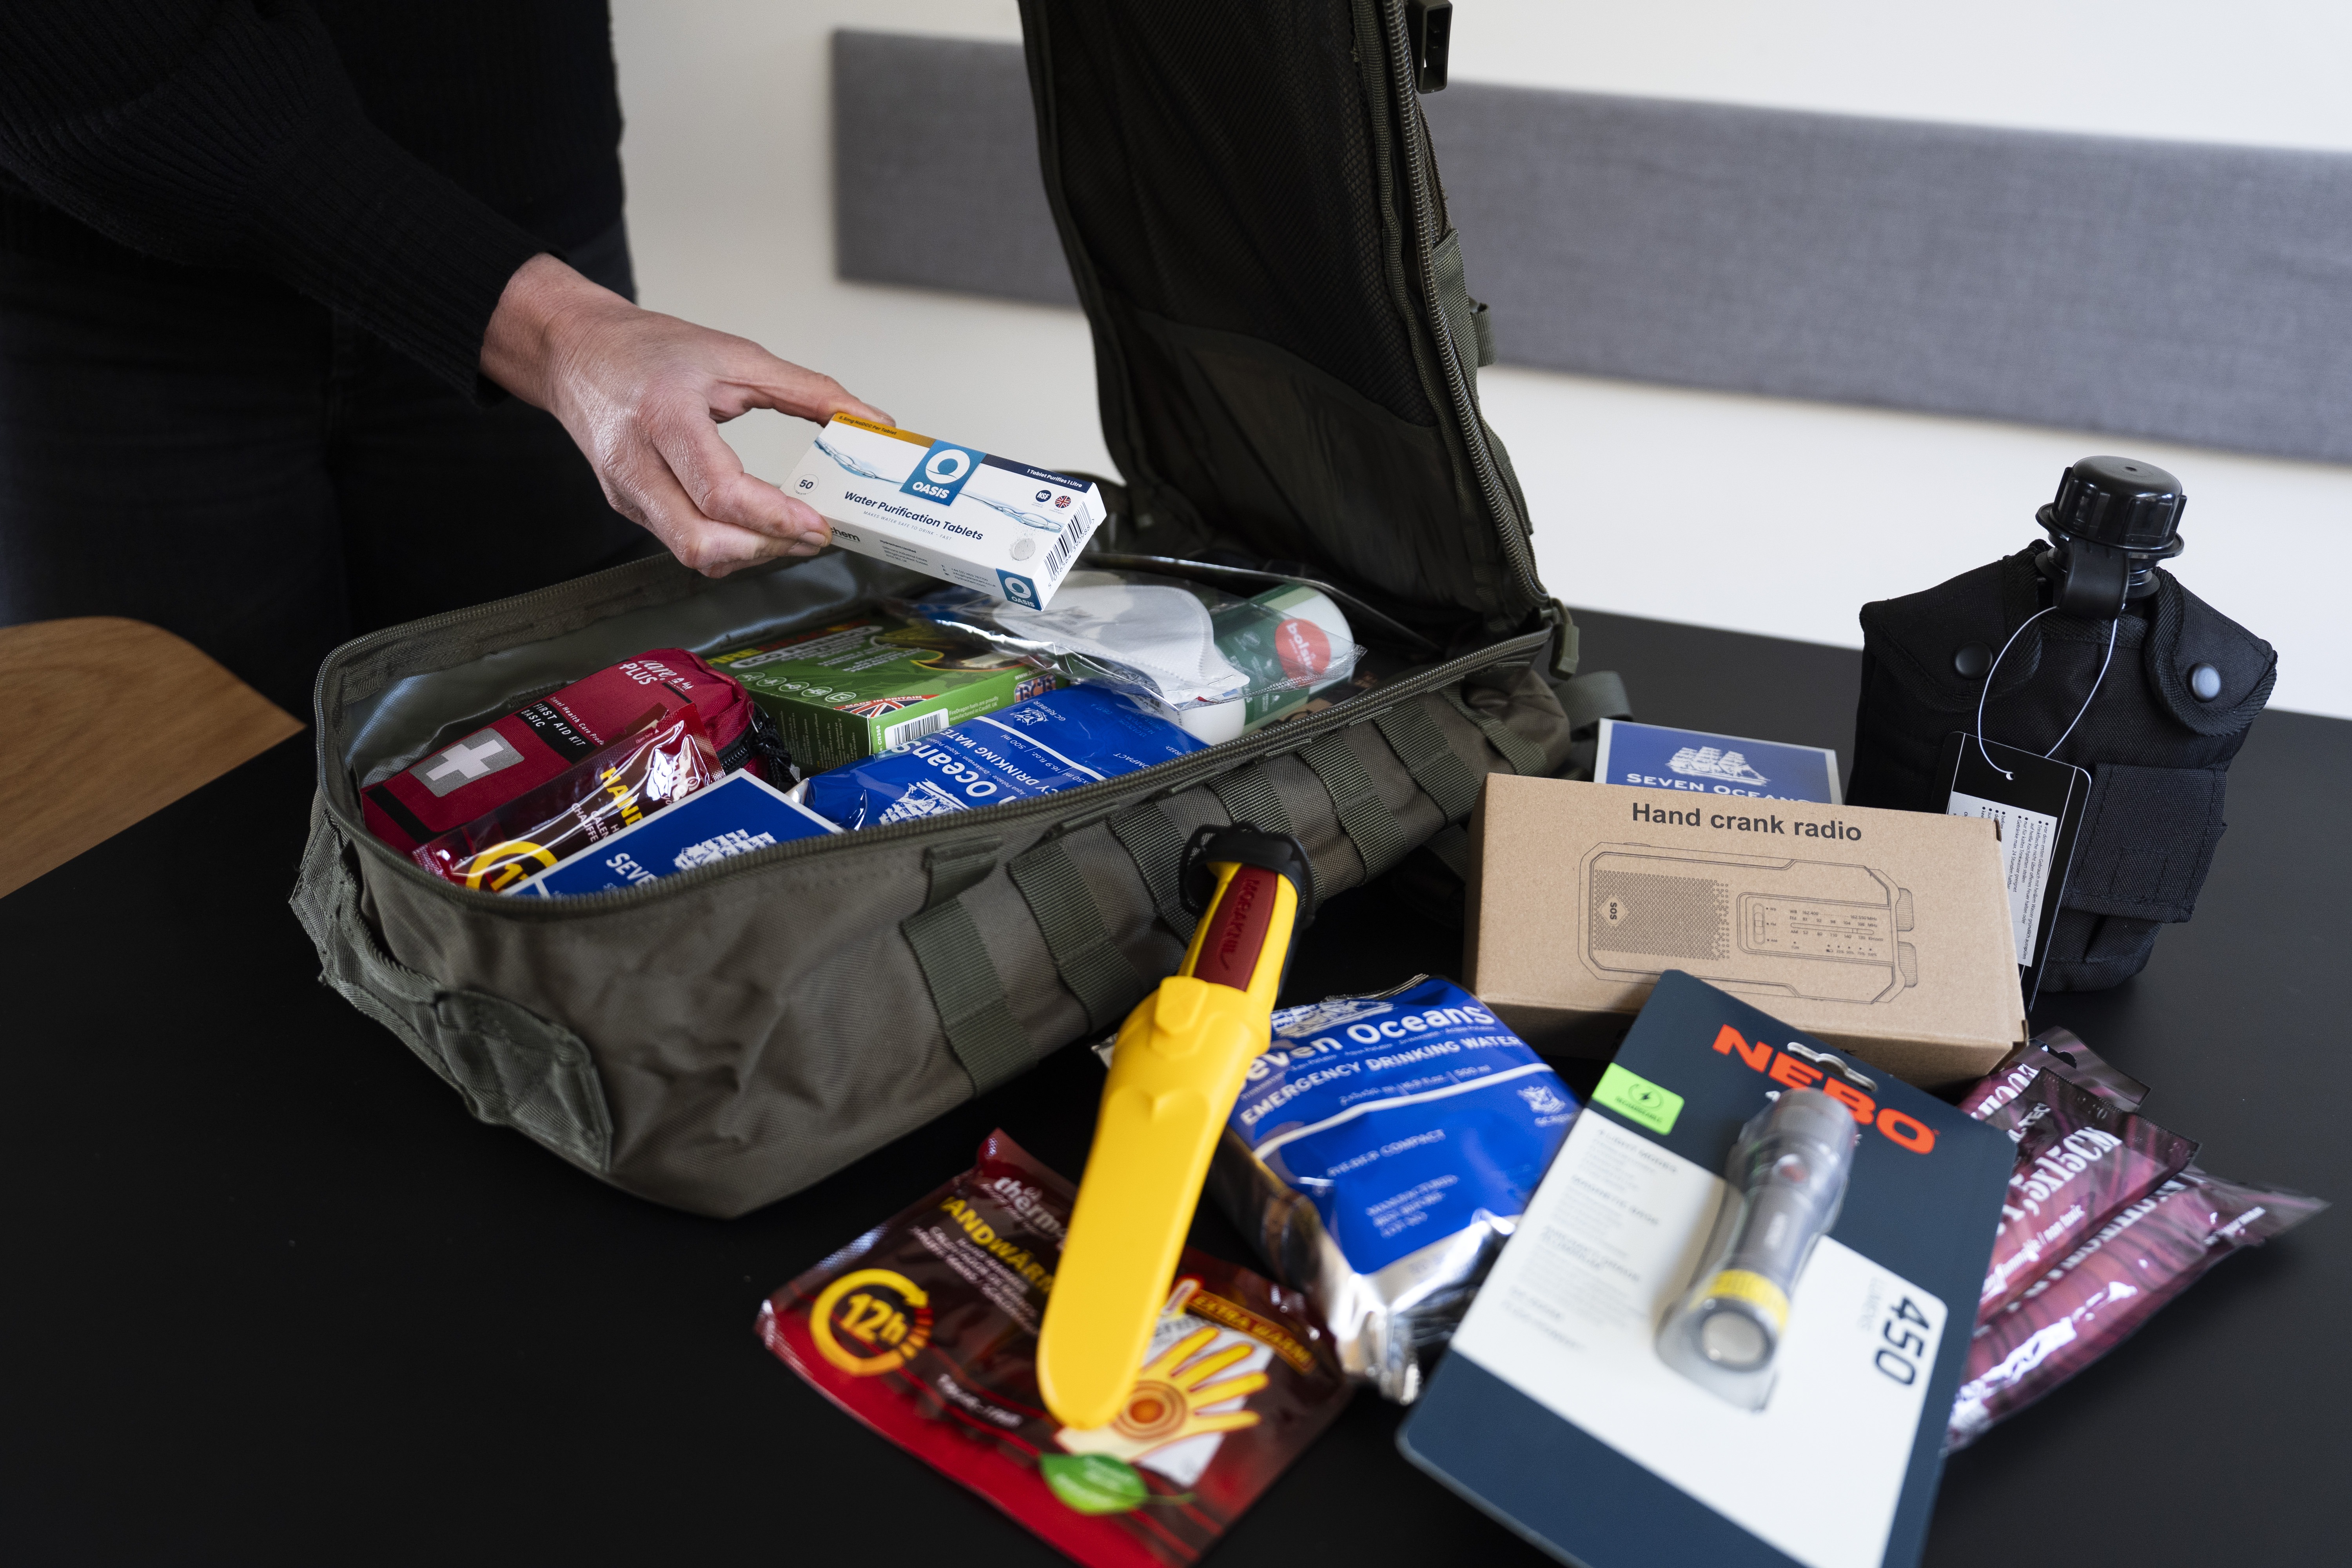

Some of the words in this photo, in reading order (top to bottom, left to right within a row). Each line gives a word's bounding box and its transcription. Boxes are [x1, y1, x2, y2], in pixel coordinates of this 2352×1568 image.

[799, 479, 813, 489] 50
[912, 481, 949, 499] OASIS
[1047, 475, 1067, 484] Purifies
[1037, 492, 1050, 500] NSF
[844, 491, 878, 507] Water
[878, 501, 944, 527] Purification
[943, 521, 984, 540] Tablets
[918, 527, 934, 535] DRINK
[1011, 596, 1035, 608] OASIS
[619, 662, 658, 685] PLUS
[949, 705, 970, 716] FireDragon
[985, 696, 999, 704] proudly
[949, 711, 974, 722] manufactured
[1033, 701, 1057, 715] RIEBER
[521, 710, 545, 727] BASIC
[533, 703, 557, 720] FIRST
[554, 722, 571, 735] AID
[569, 736, 586, 745] KIT
[550, 697, 564, 707] Travel
[562, 706, 580, 723] Health
[579, 723, 591, 733] Care
[590, 733, 604, 745] Produ
[940, 728, 980, 748] WATE
[1010, 740, 1026, 749] 500
[944, 745, 960, 755] Acqua
[1113, 753, 1150, 768] OMPACT
[891, 740, 997, 797] Oceans
[962, 755, 990, 774] Drikkevann
[975, 747, 1040, 786] DRINKING
[1045, 760, 1060, 773] 16.9
[992, 775, 1010, 788] Potable
[1011, 787, 1026, 795] Agua
[1626, 773, 1704, 791] SEVEN
[1713, 785, 1810, 802] OCEA
[571, 803, 599, 842] CHAUFFE
[1632, 802, 1701, 827] Hand
[1710, 813, 1785, 835] crank
[1794, 821, 1862, 841] radio
[2034, 825, 2042, 848] Trinkflasche
[606, 853, 659, 886] SEVE
[1246, 1037, 1344, 1081] even
[1347, 1005, 1495, 1044] Oceans
[1240, 1061, 1361, 1126] EMERGENCY
[1365, 1041, 1461, 1071] DRINKING
[1460, 1036, 1523, 1050] WATER
[1712, 1024, 1936, 1154] NEBO
[993, 1176, 1068, 1238] therm
[940, 1195, 1054, 1292] ANDWÄRM
[840, 1293, 911, 1345] 12h
[1873, 1294, 1933, 1388] 450
